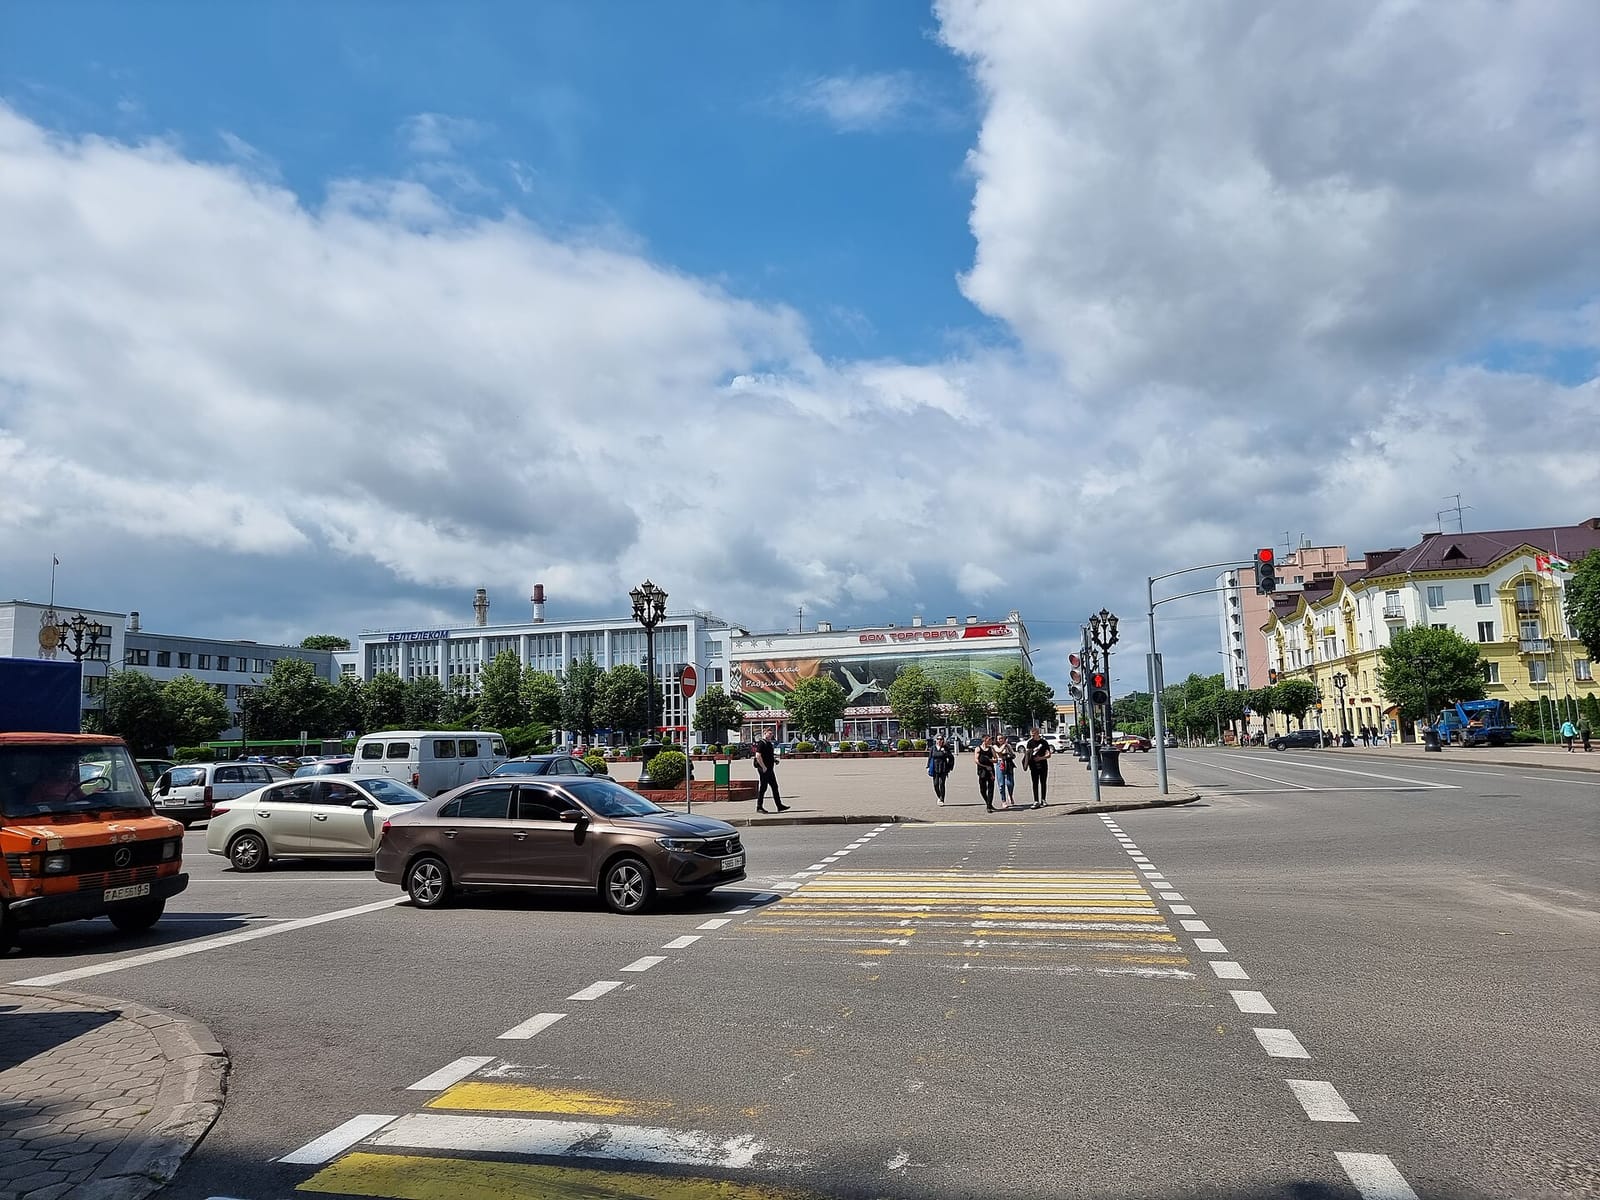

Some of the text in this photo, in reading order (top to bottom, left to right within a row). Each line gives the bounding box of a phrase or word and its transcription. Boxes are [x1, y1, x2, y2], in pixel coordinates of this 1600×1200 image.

[388, 630, 449, 641] БЕЛТЕЛЕКОМ
[859, 629, 958, 643] ДОМ ТОРГОВЛИ
